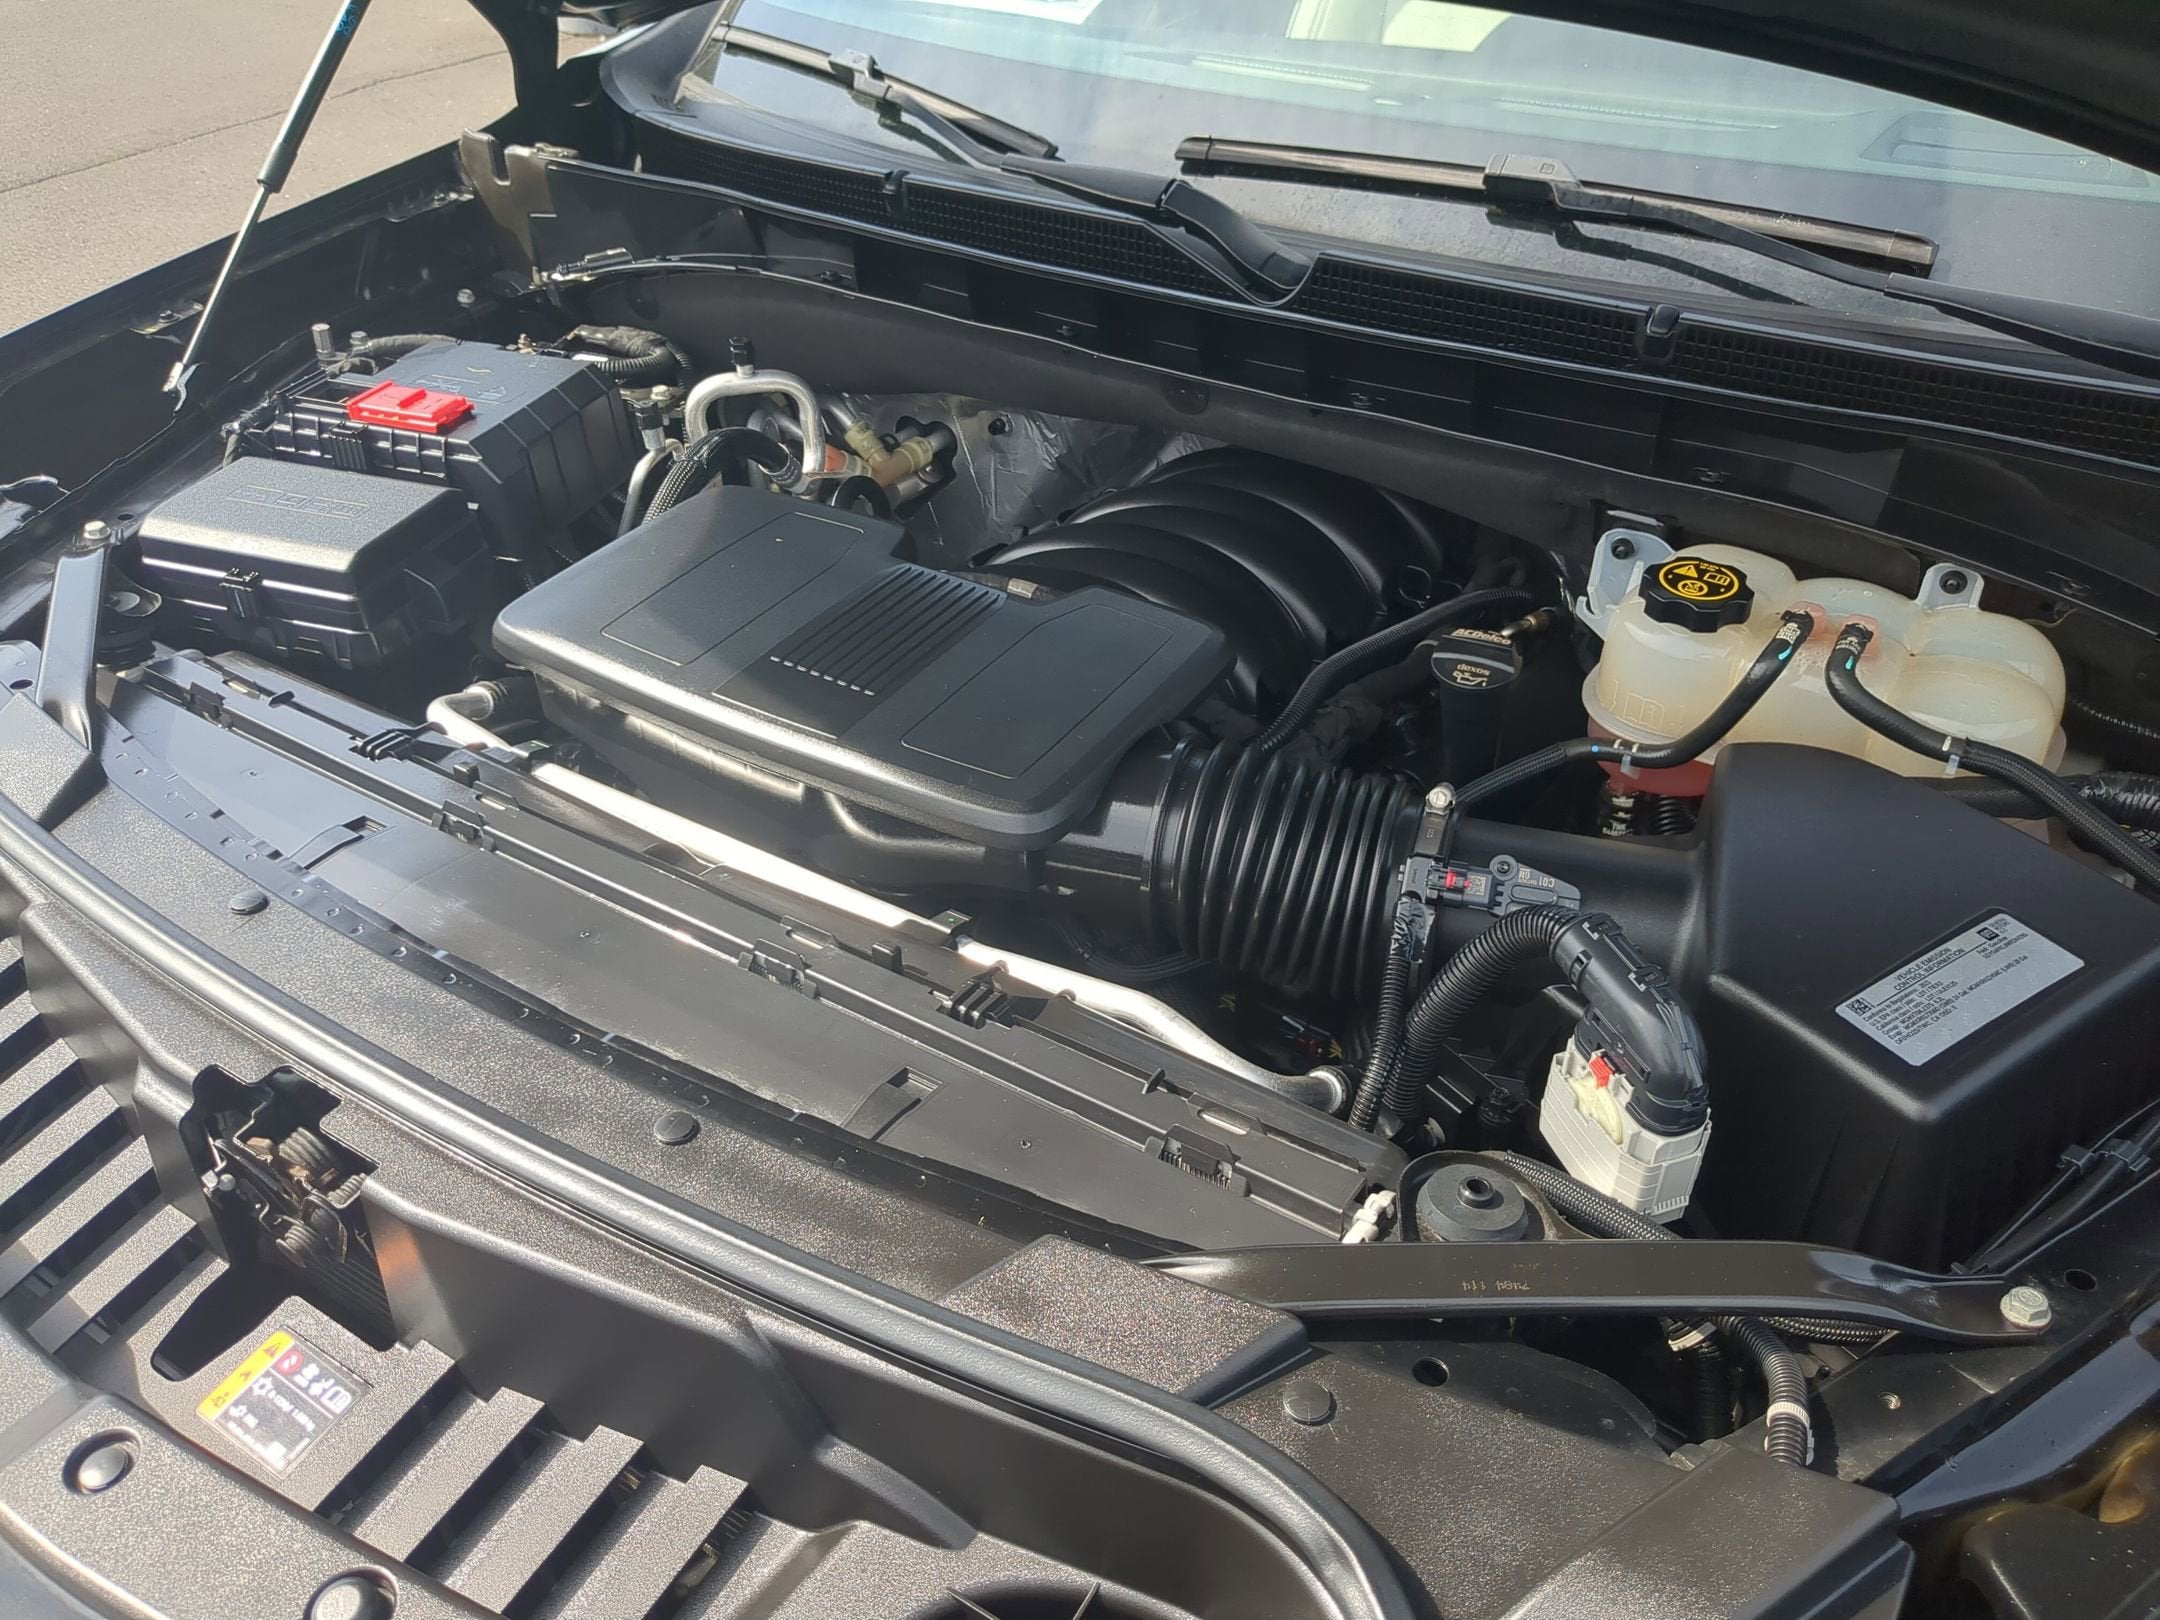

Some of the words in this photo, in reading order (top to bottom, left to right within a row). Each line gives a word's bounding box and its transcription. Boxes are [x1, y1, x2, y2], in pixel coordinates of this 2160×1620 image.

[1450, 628, 1512, 645] ACDelco
[1457, 663, 1491, 676] dexos
[1892, 970, 1926, 991] CONTROL
[1921, 946, 1967, 974] INFORMATION
[1893, 962, 1925, 982] VEHICLE
[1919, 946, 1953, 967] EMISSION
[1873, 1014, 1900, 1031] California
